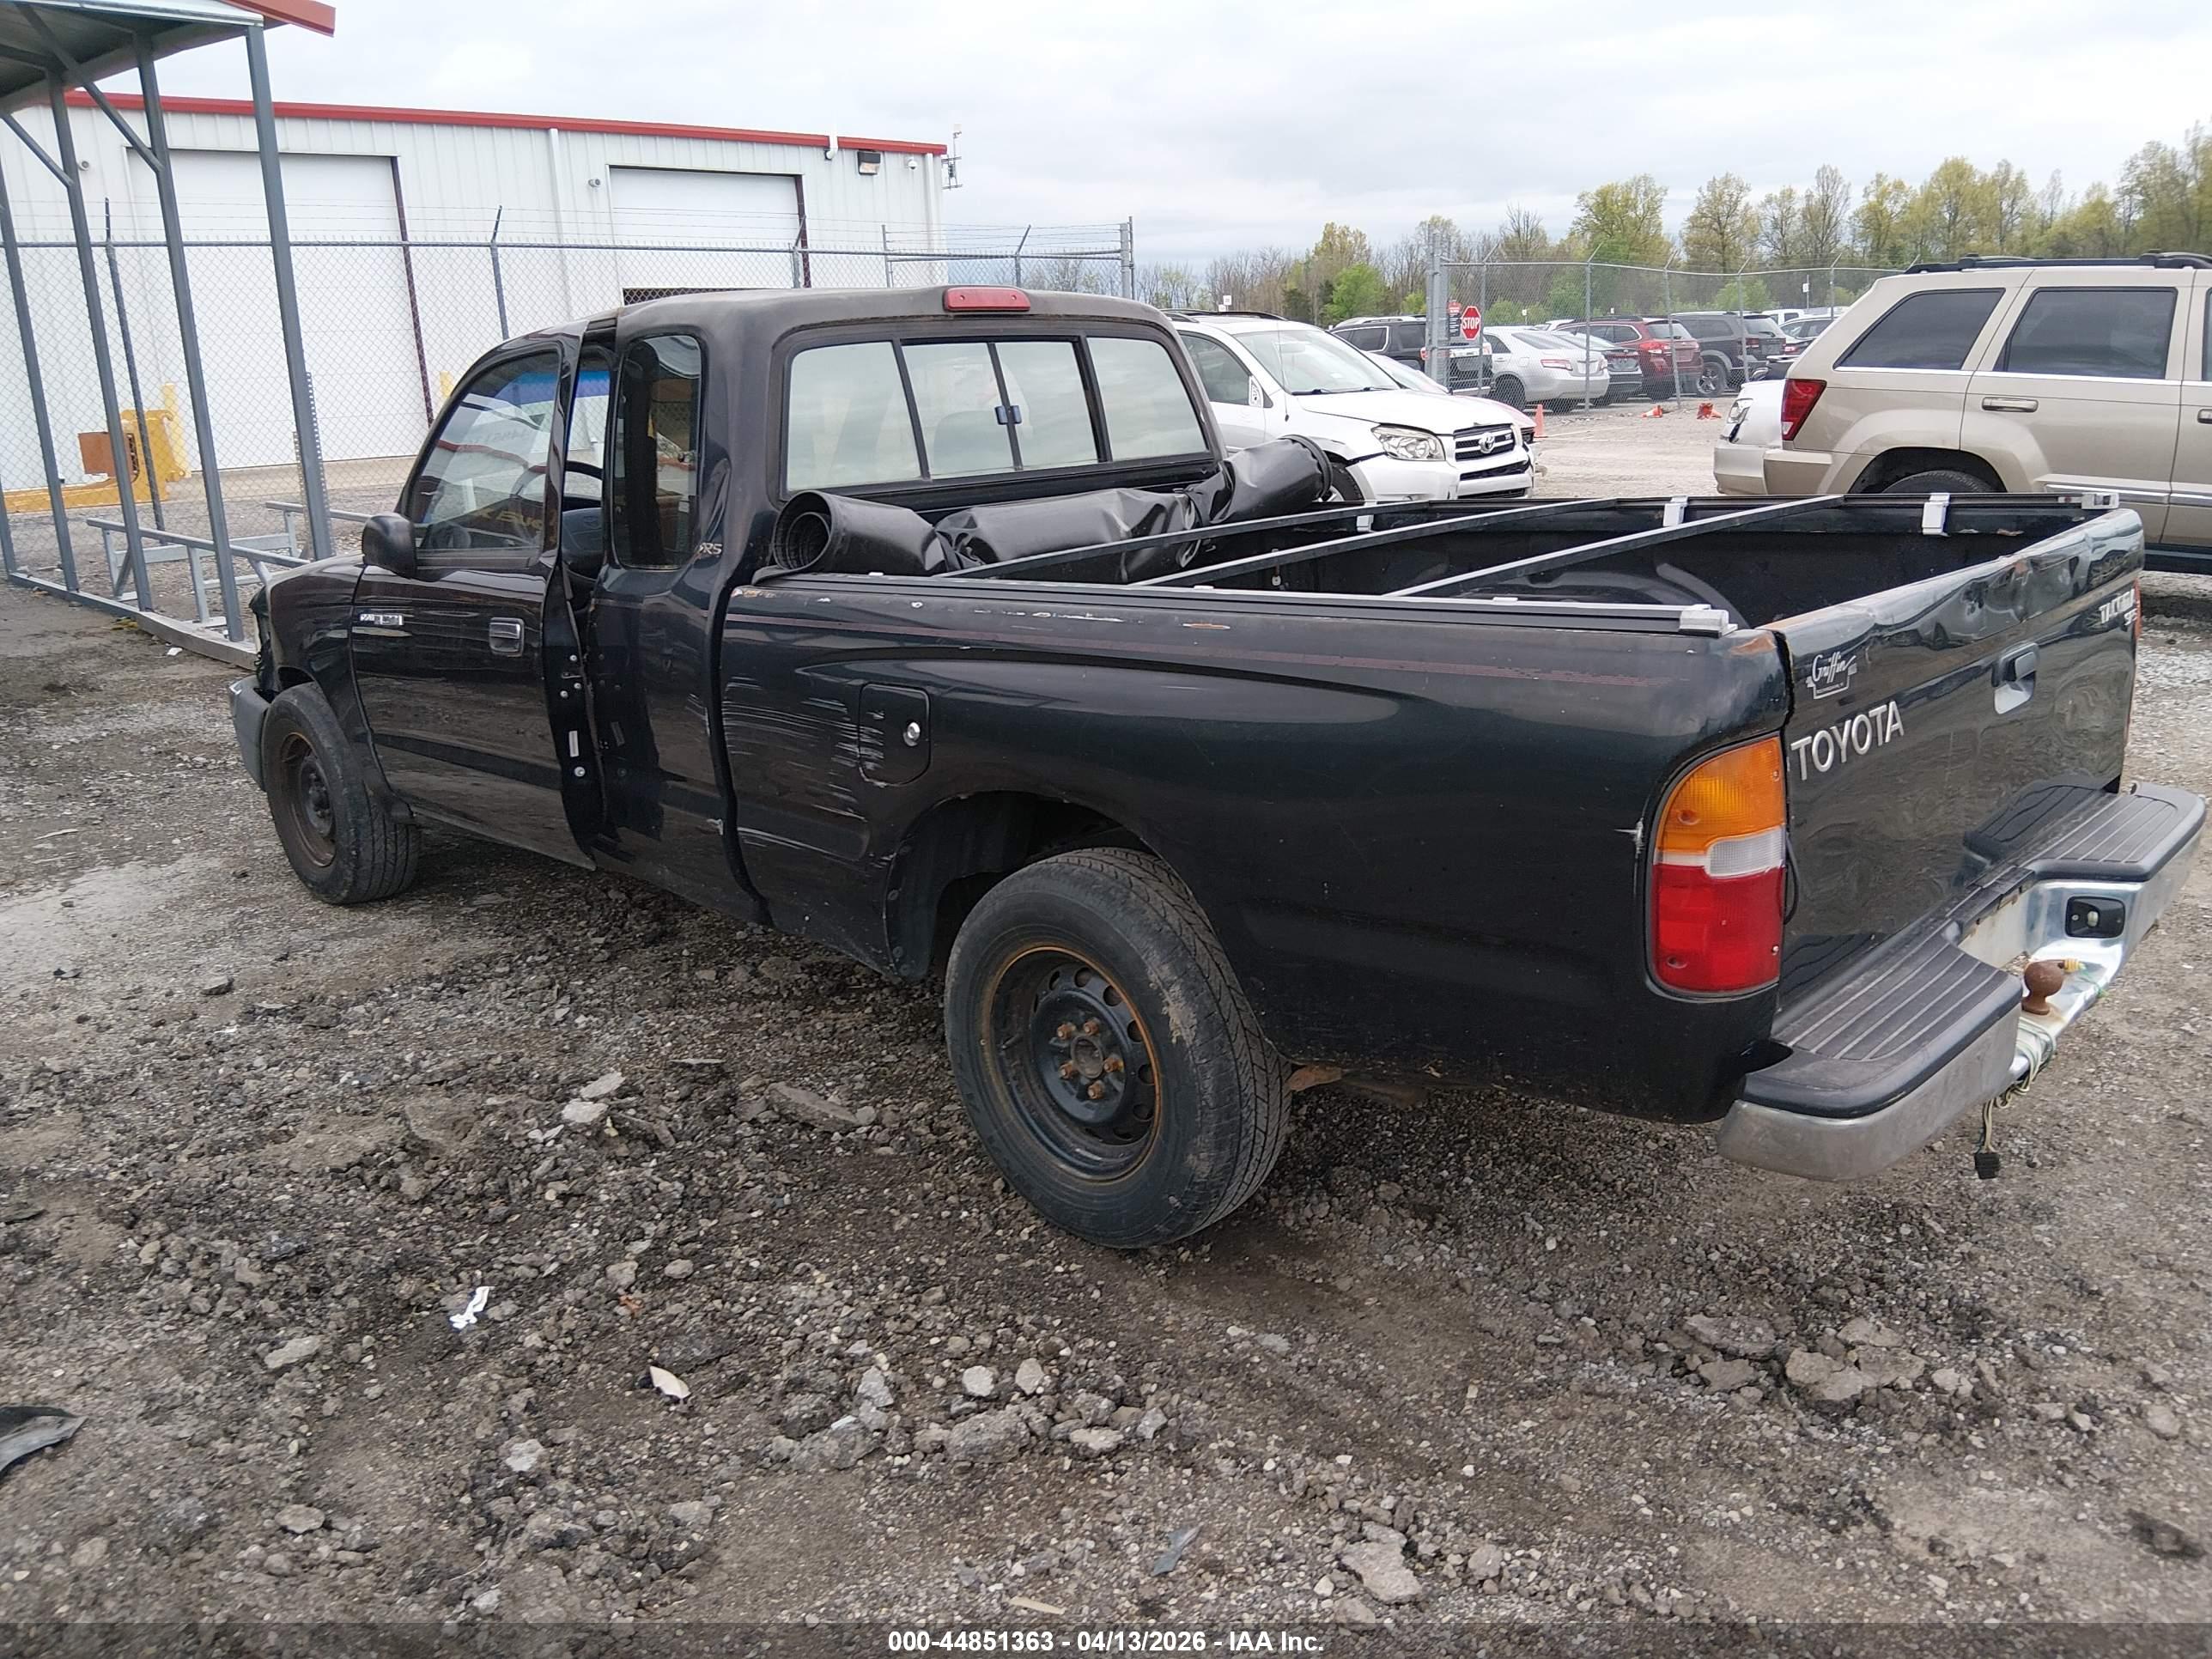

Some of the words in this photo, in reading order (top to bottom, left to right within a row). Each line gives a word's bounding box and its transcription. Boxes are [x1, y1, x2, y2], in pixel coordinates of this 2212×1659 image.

[1462, 317, 1480, 330] STOP
[1812, 651, 1857, 684] Griffin
[1790, 700, 1905, 781] TOYOTA
